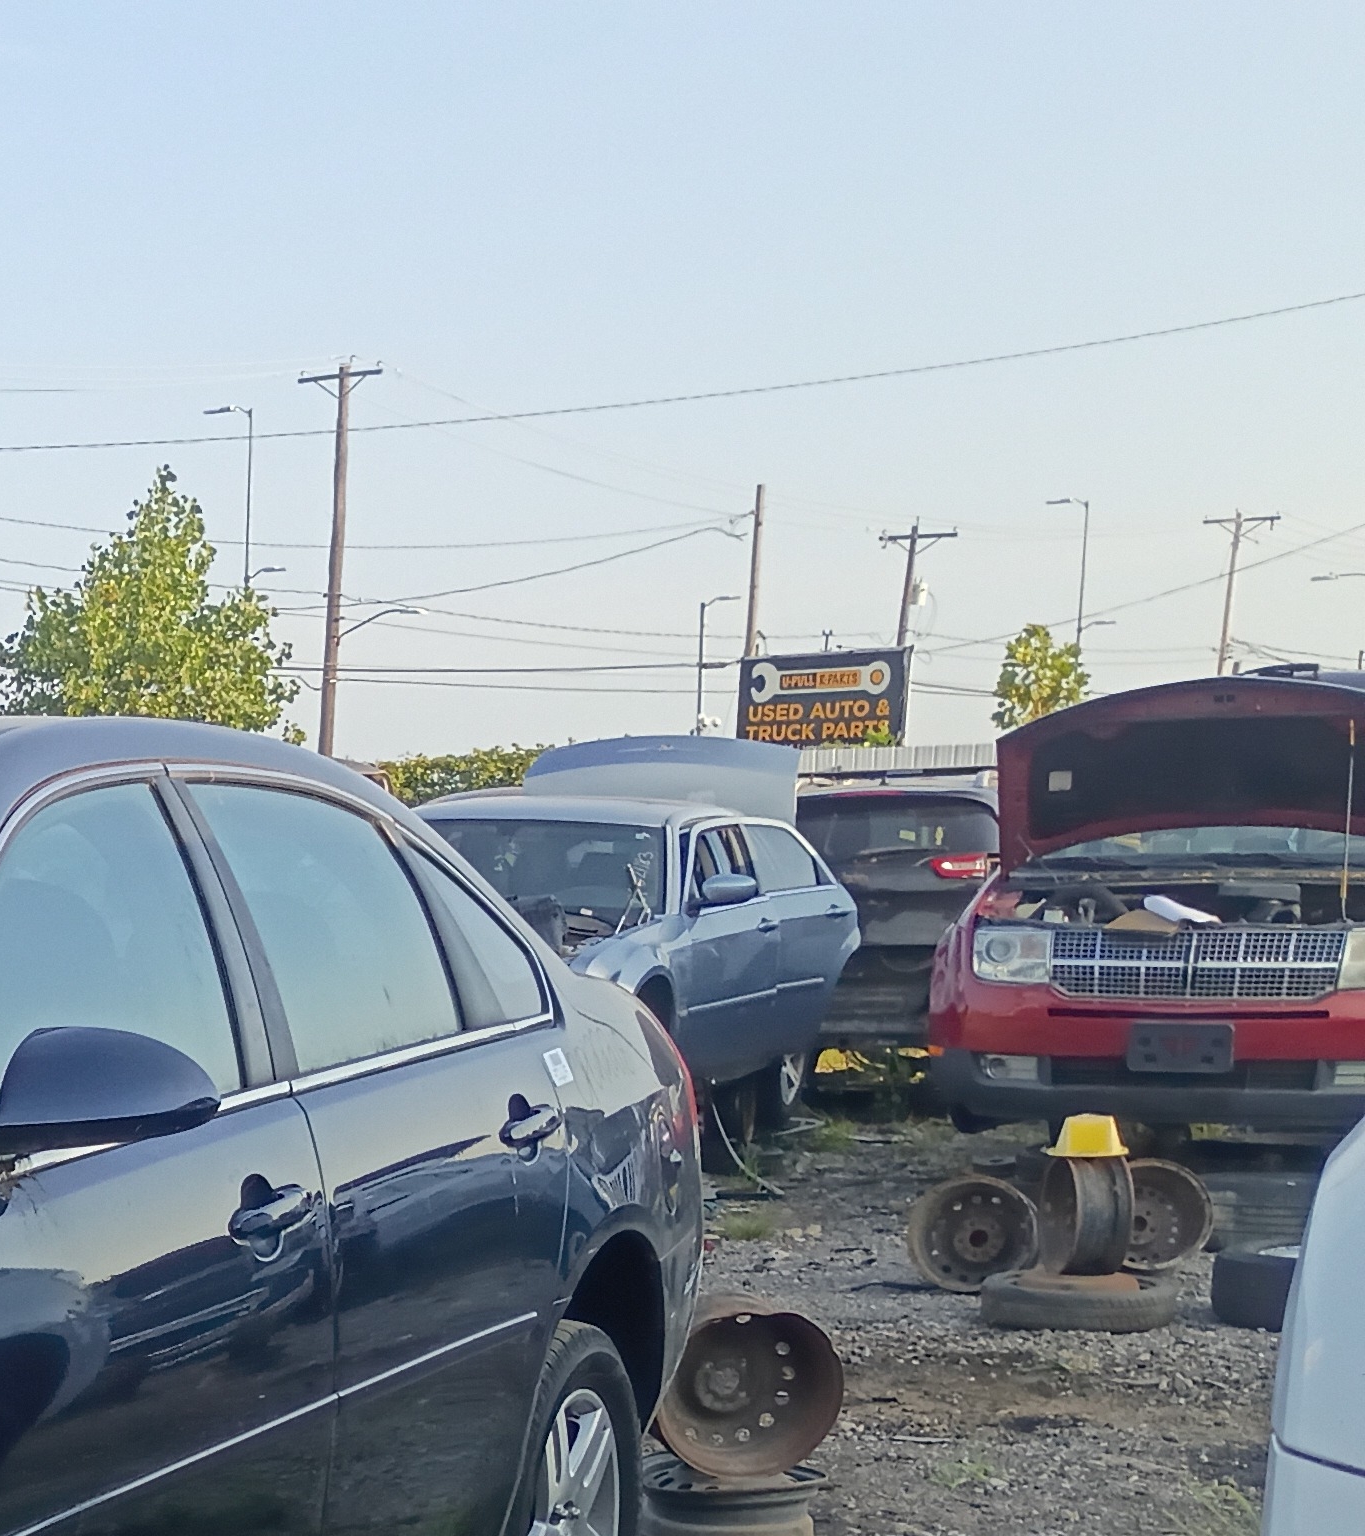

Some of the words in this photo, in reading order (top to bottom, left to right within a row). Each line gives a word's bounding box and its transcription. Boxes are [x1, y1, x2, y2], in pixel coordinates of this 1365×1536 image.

[748, 703, 803, 721] USED
[810, 699, 870, 719] AUTO
[876, 699, 890, 716] &
[746, 723, 815, 741] TRUCK
